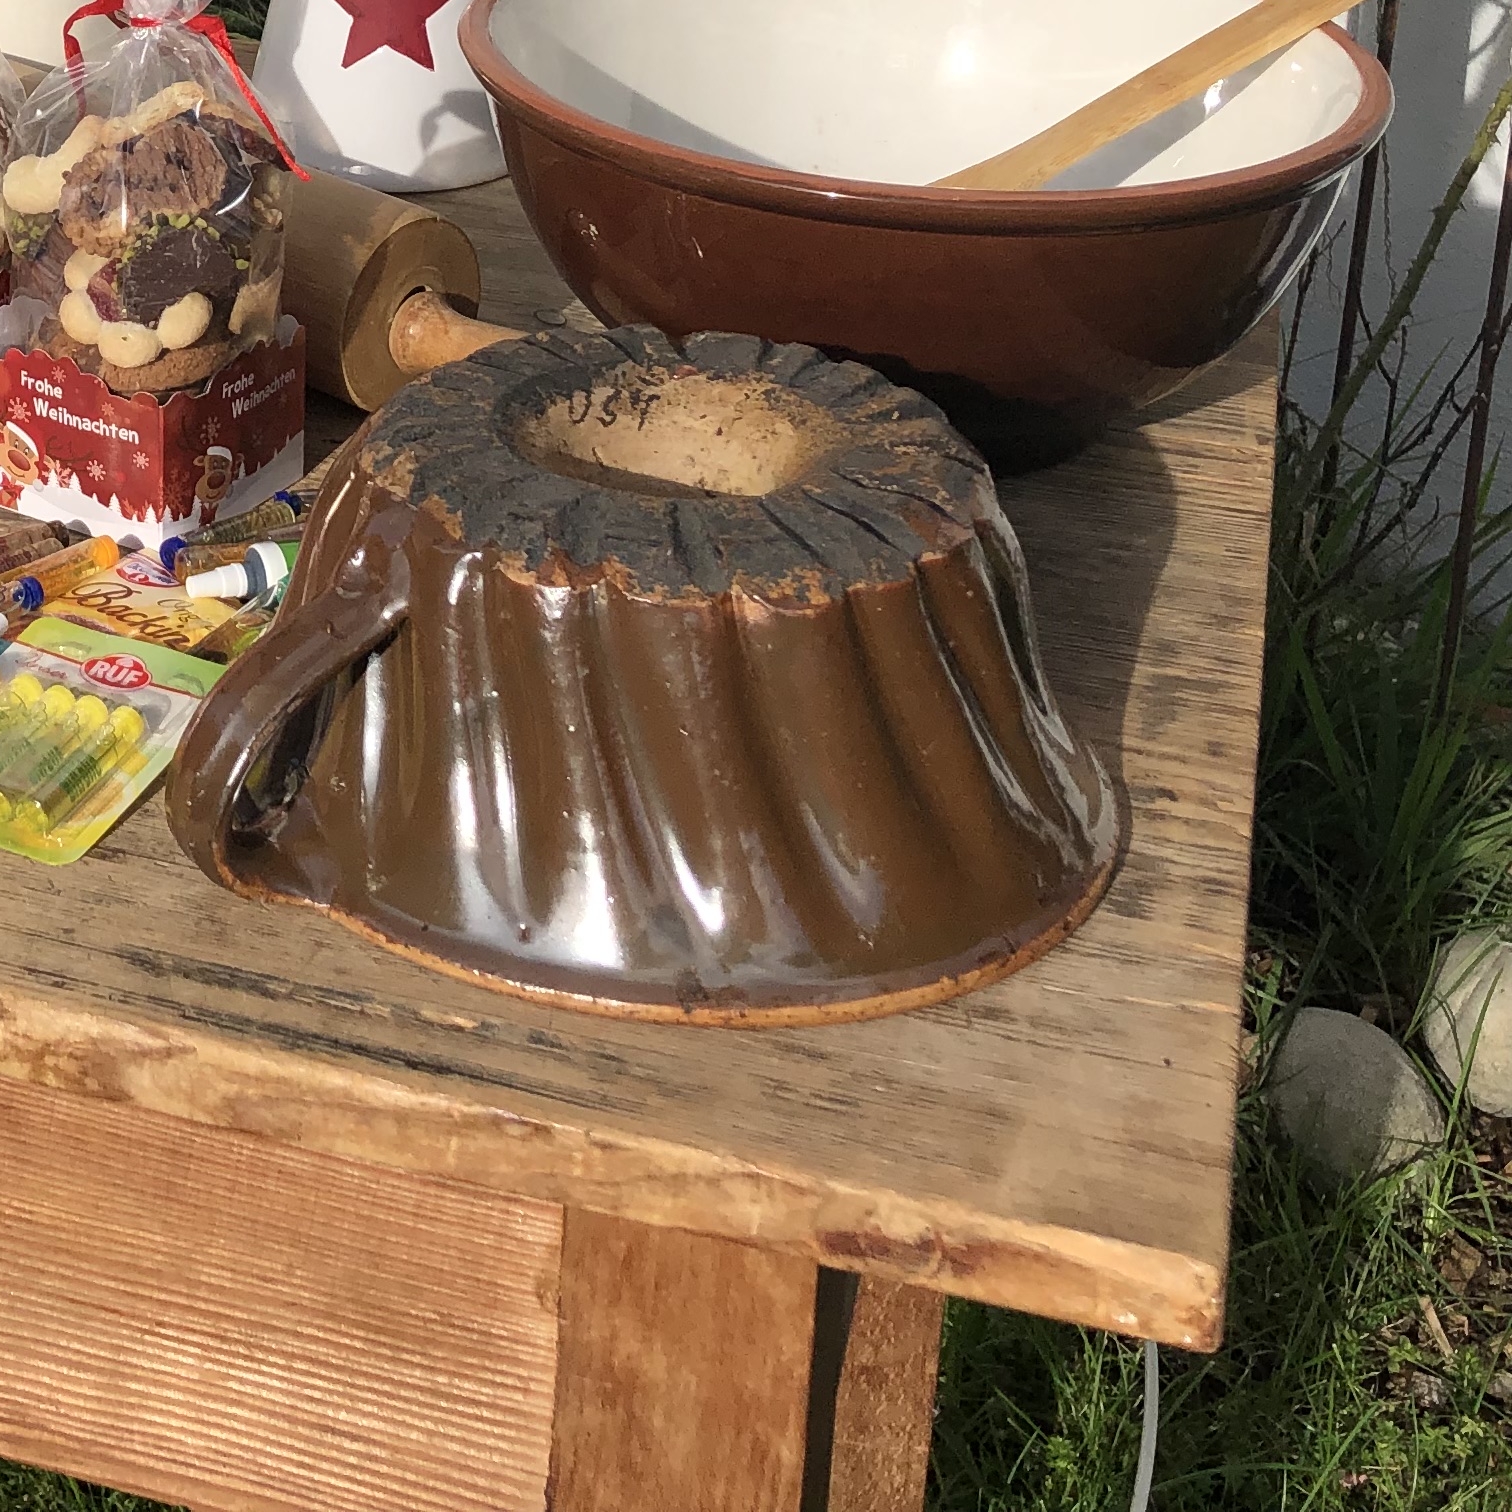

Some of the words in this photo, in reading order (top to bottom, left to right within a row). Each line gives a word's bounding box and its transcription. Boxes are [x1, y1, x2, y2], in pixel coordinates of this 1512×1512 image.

[20, 370, 63, 399] Frohe
[222, 373, 255, 399] Frohe
[232, 368, 296, 419] Weihnachten
[33, 397, 139, 445] Weihnachten
[57, 581, 191, 653] Backin
[88, 659, 144, 686] RUF
